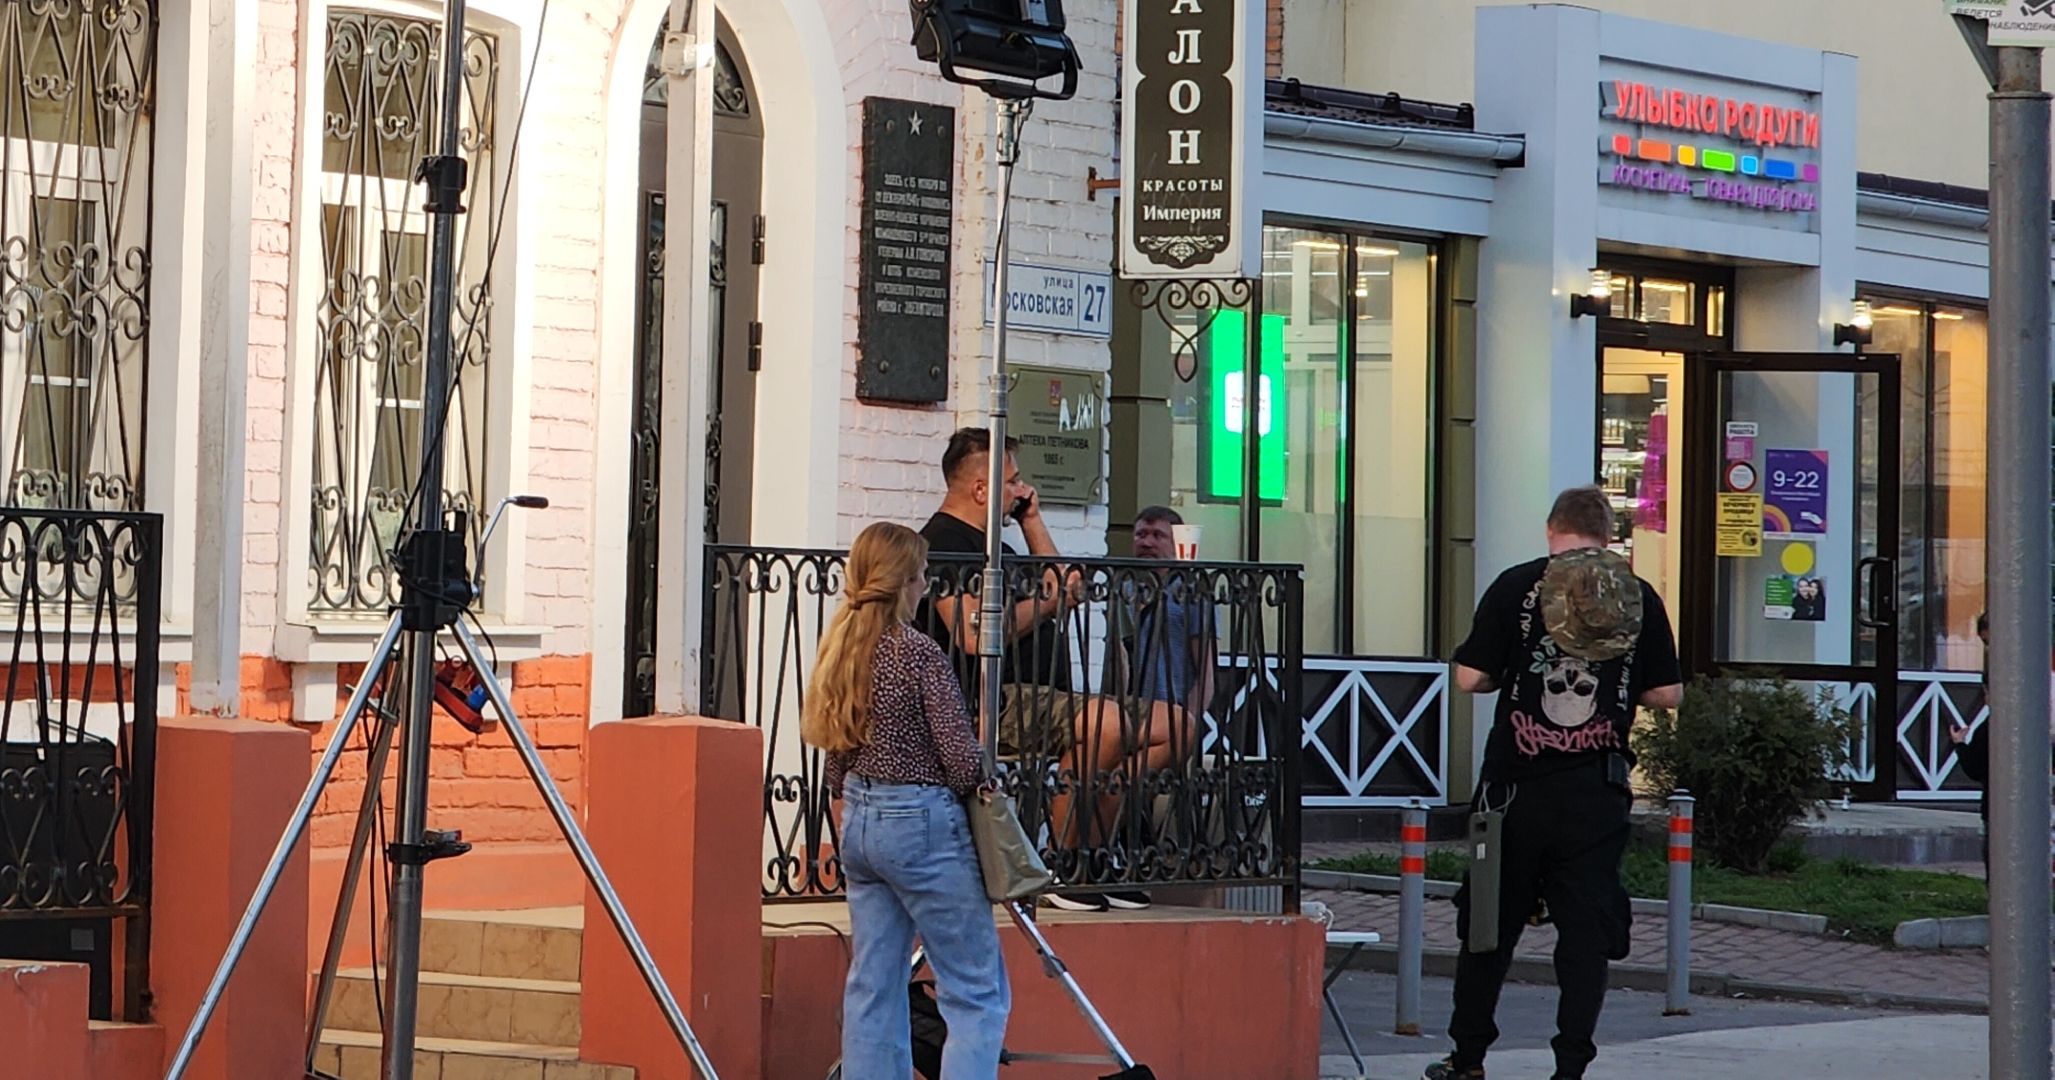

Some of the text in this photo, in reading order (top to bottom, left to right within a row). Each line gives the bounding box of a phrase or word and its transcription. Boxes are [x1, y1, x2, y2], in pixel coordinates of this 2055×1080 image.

[1143, 179, 1223, 192] КРАСОТЫ
[1143, 205, 1223, 223] Империя
[1043, 275, 1074, 289] улица
[1084, 283, 1106, 323] 27
[1773, 470, 1819, 488] 9-22
